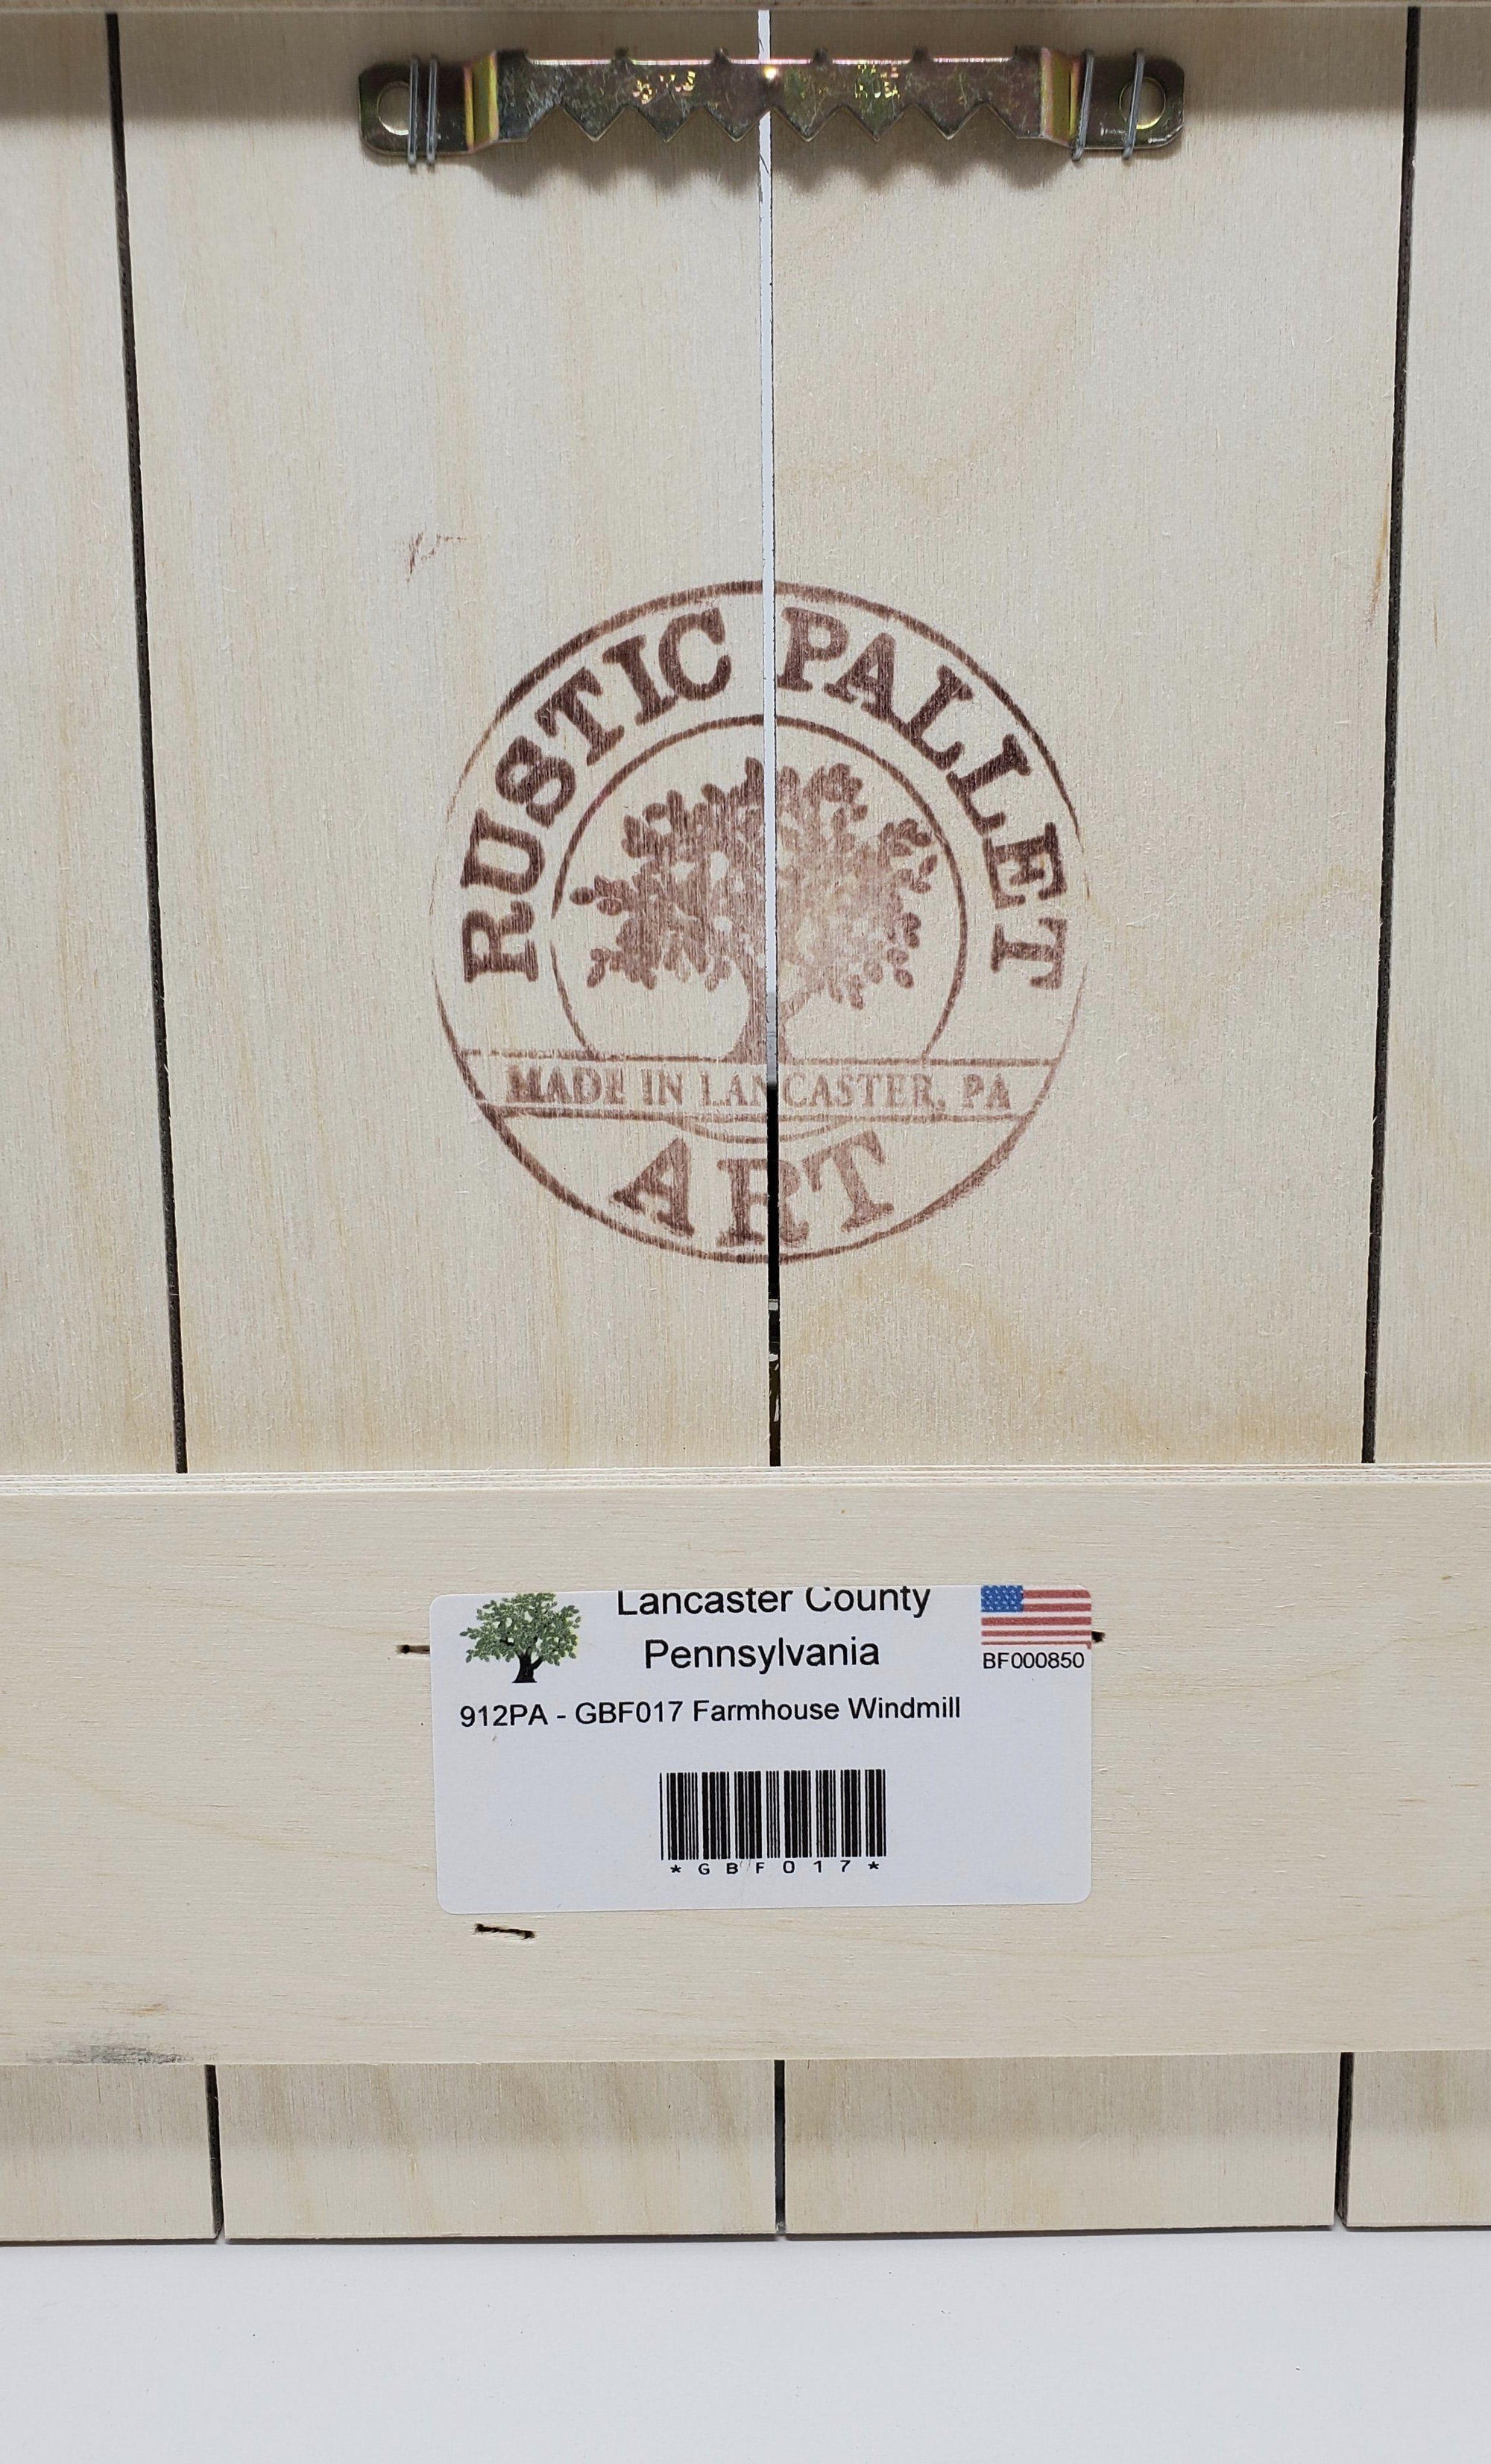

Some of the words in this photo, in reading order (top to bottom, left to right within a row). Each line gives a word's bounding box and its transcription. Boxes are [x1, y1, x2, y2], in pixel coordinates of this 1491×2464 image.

[460, 607, 732, 983] RUSTIC
[777, 607, 1068, 990] PALLET
[505, 1065, 622, 1105] MADE
[640, 1068, 682, 1106] IN
[699, 1070, 946, 1113] LANCASTER,
[962, 1073, 1011, 1110] PA
[609, 1130, 895, 1248] ART
[617, 1588, 793, 1616] Lancaster
[805, 1585, 931, 1618] County
[645, 1636, 880, 1675] Pennsylvania
[983, 1652, 1085, 1669] BF000850
[459, 1703, 548, 1728] 912PA
[575, 1701, 683, 1725] GBF017
[693, 1698, 839, 1722] Farmhouse
[848, 1696, 961, 1719] Windmill
